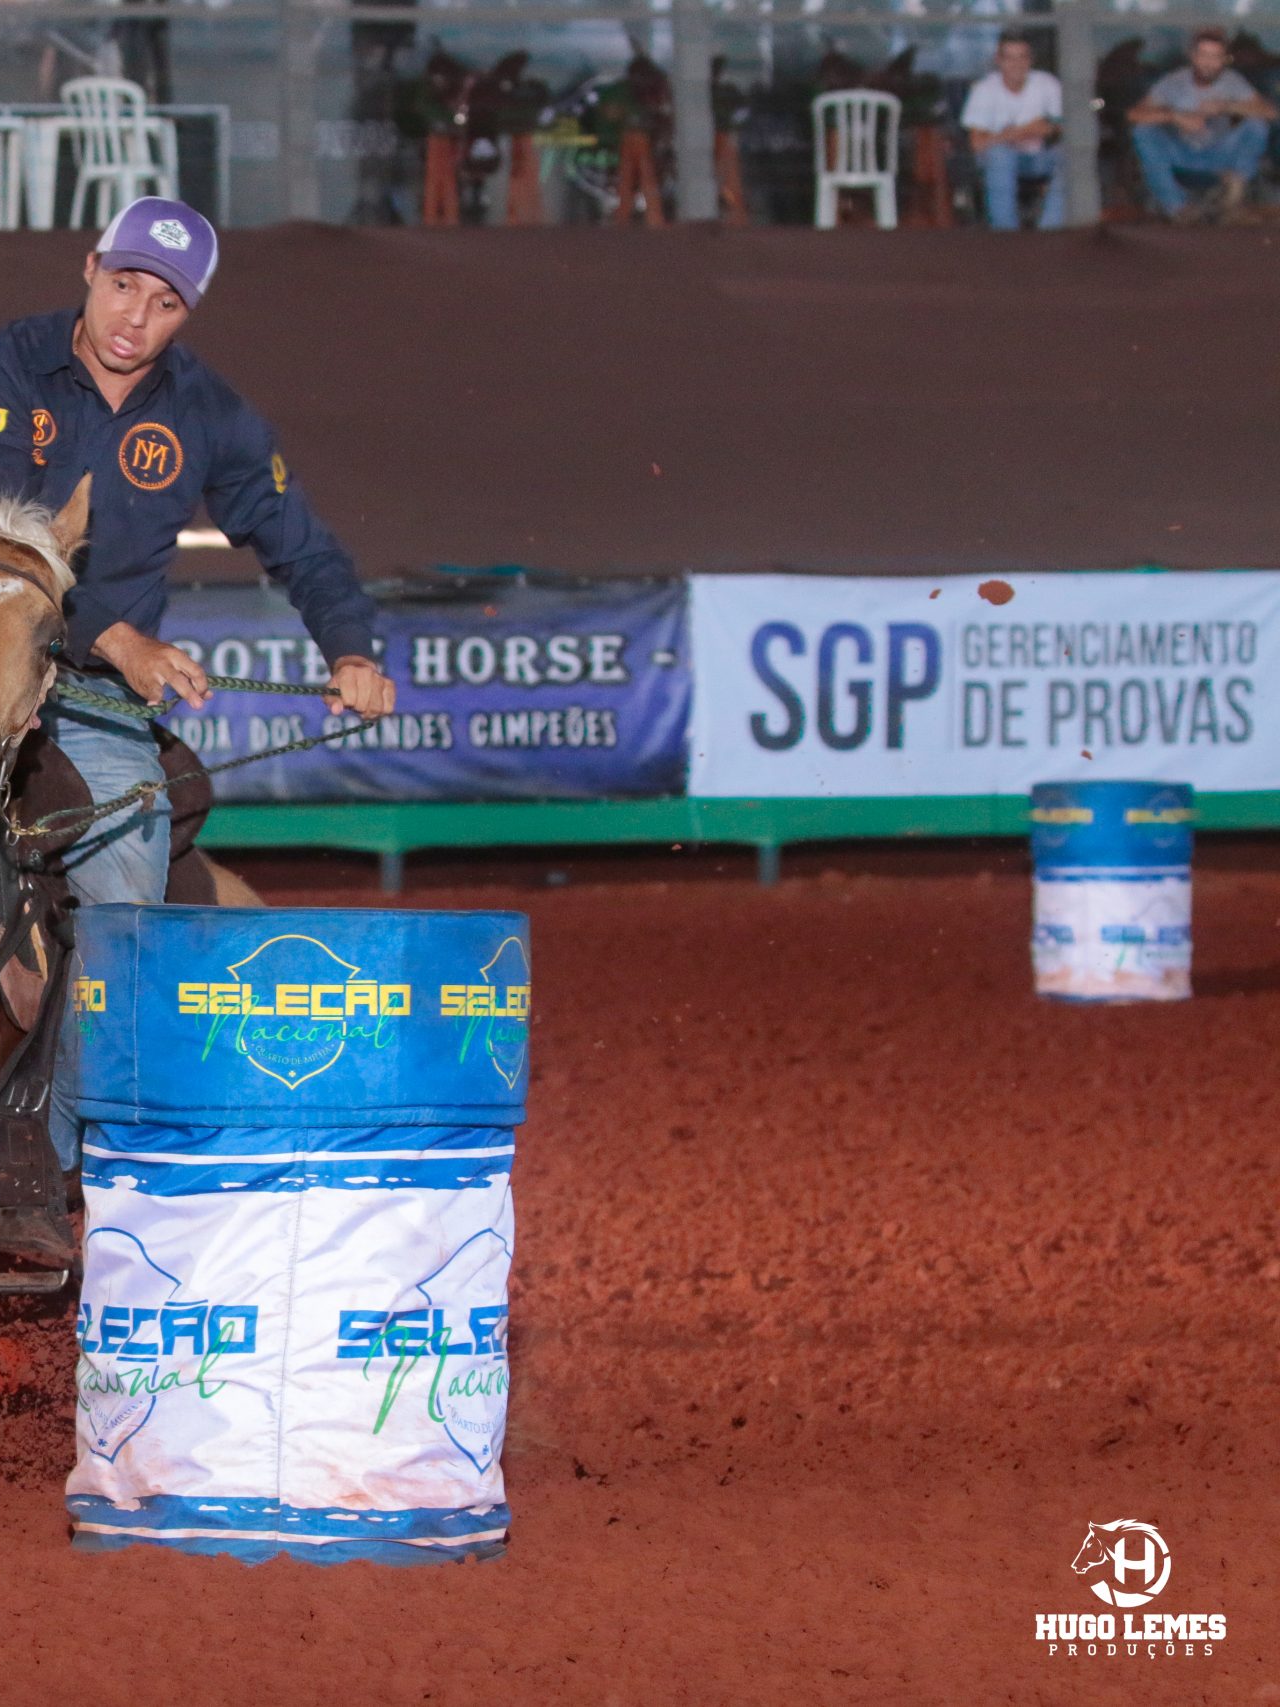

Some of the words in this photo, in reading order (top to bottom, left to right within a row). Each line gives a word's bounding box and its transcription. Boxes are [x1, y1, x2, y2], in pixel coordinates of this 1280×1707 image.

[413, 634, 628, 683] HORSE
[962, 620, 1257, 669] GERENCIAMENTO
[750, 620, 942, 751] SGP
[249, 715, 303, 753] DOS
[323, 713, 453, 750] GRANDES
[470, 707, 618, 749] CAMPEÕES
[962, 680, 1028, 749] DE
[1048, 677, 1255, 747] PROVAS
[178, 979, 411, 1021] SELEÇÃO
[195, 993, 400, 1063] Nacional
